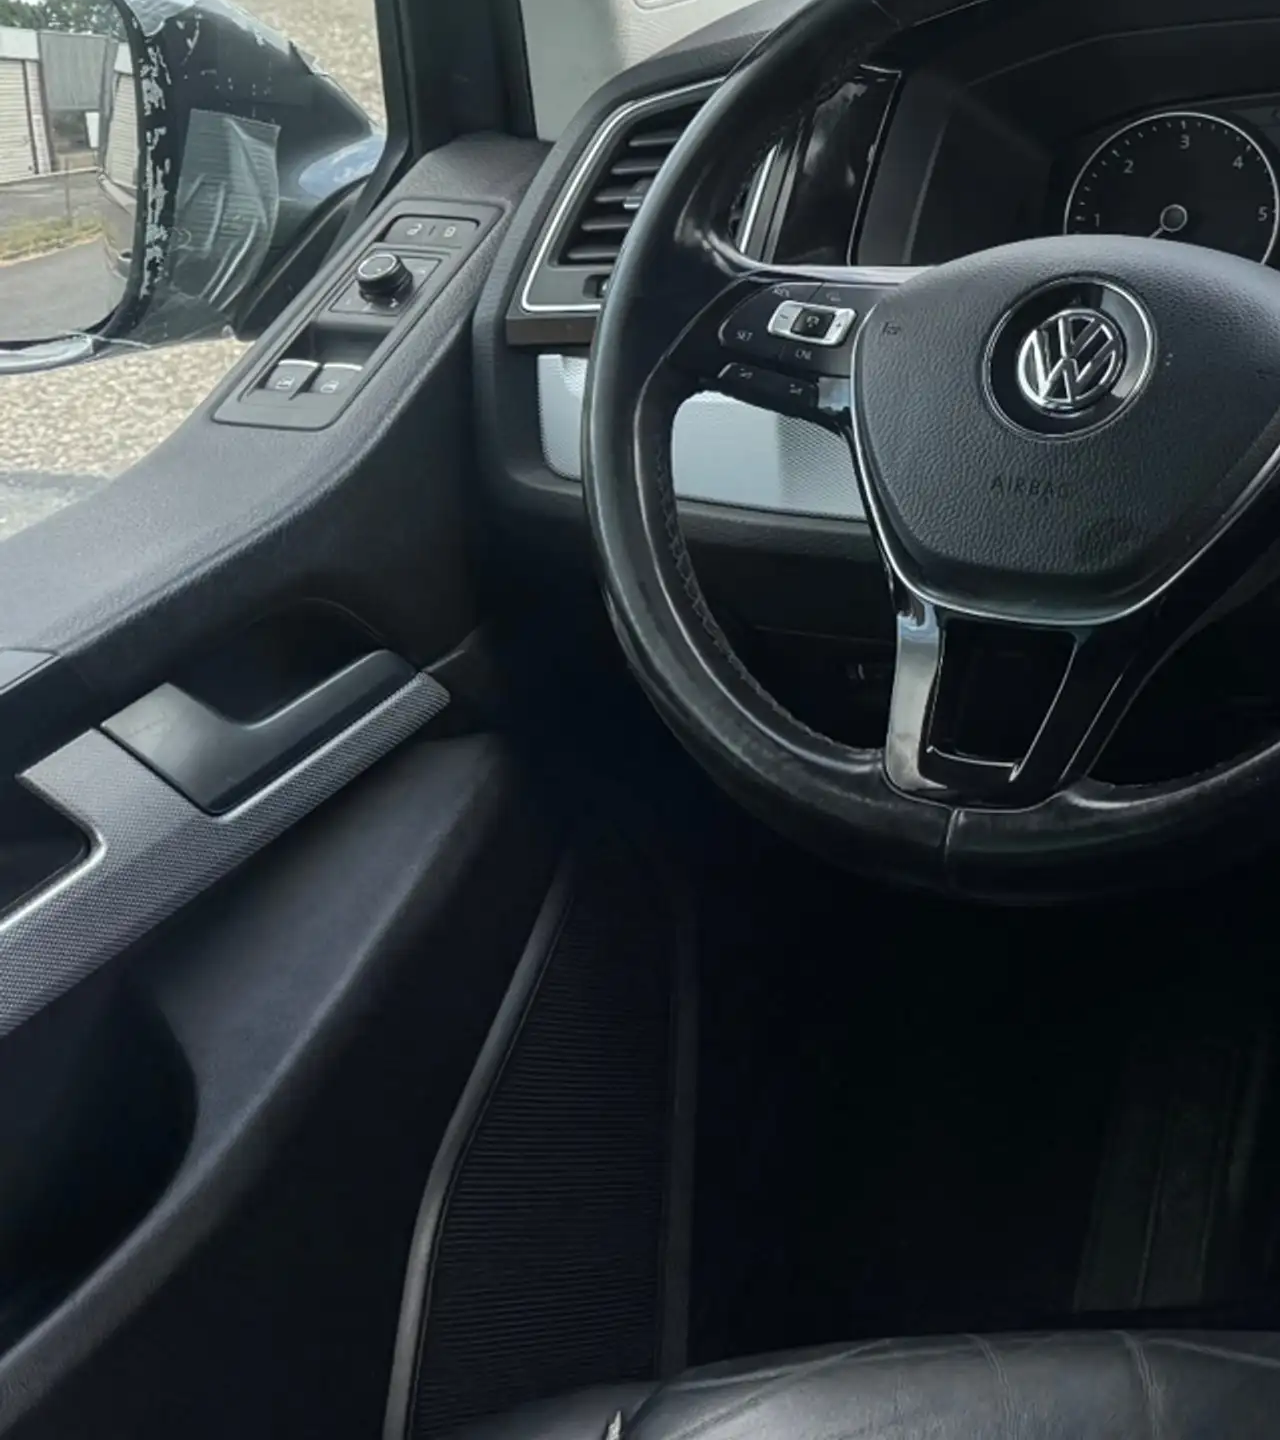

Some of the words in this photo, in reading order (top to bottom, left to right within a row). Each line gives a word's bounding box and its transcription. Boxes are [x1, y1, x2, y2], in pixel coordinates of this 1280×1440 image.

[1179, 135, 1190, 149] 3
[1123, 160, 1134, 173] 2
[1232, 156, 1244, 169] 4
[1094, 214, 1100, 227] 1
[1258, 207, 1268, 221] 5
[736, 330, 753, 341] SET
[990, 476, 1070, 499] AIRBAG
